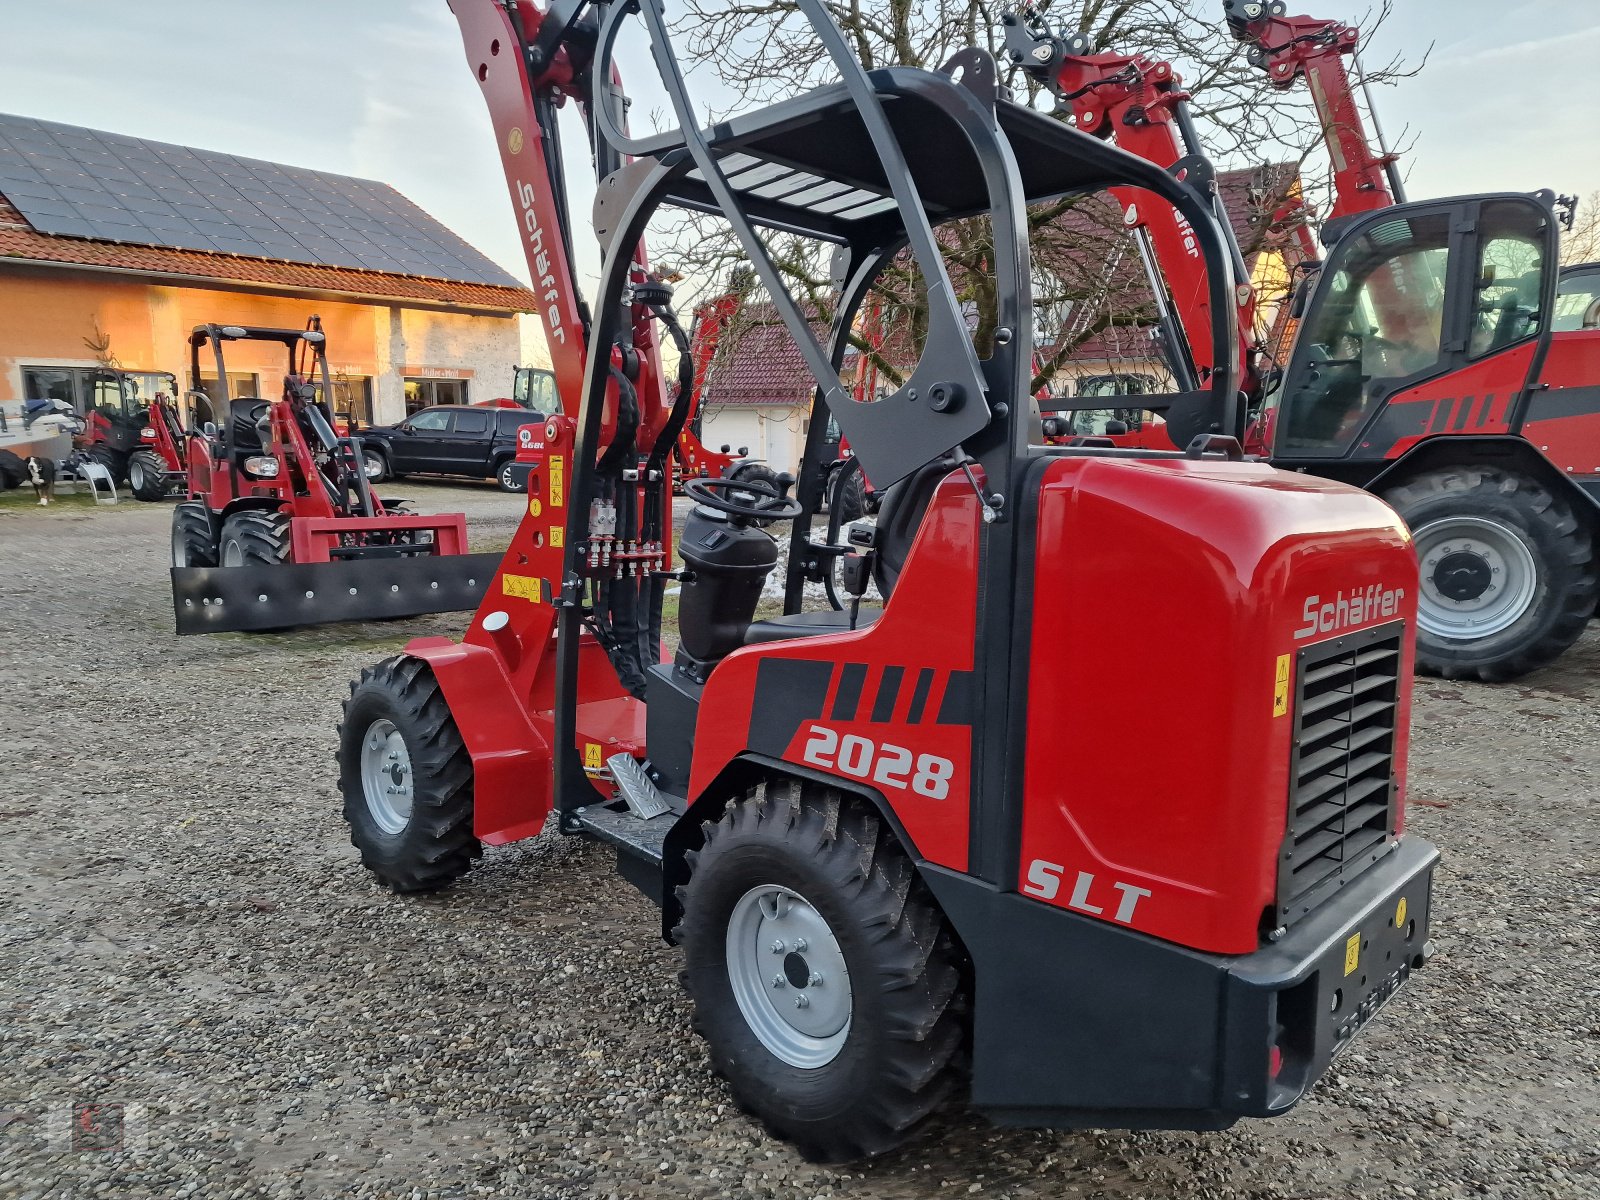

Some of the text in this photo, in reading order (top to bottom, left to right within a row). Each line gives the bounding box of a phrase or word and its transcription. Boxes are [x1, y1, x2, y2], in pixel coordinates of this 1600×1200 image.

[516, 179, 565, 344] Schäffer
[1294, 583, 1404, 639] Schäffer
[803, 725, 954, 800] 2028
[1023, 859, 1152, 923] SLT
